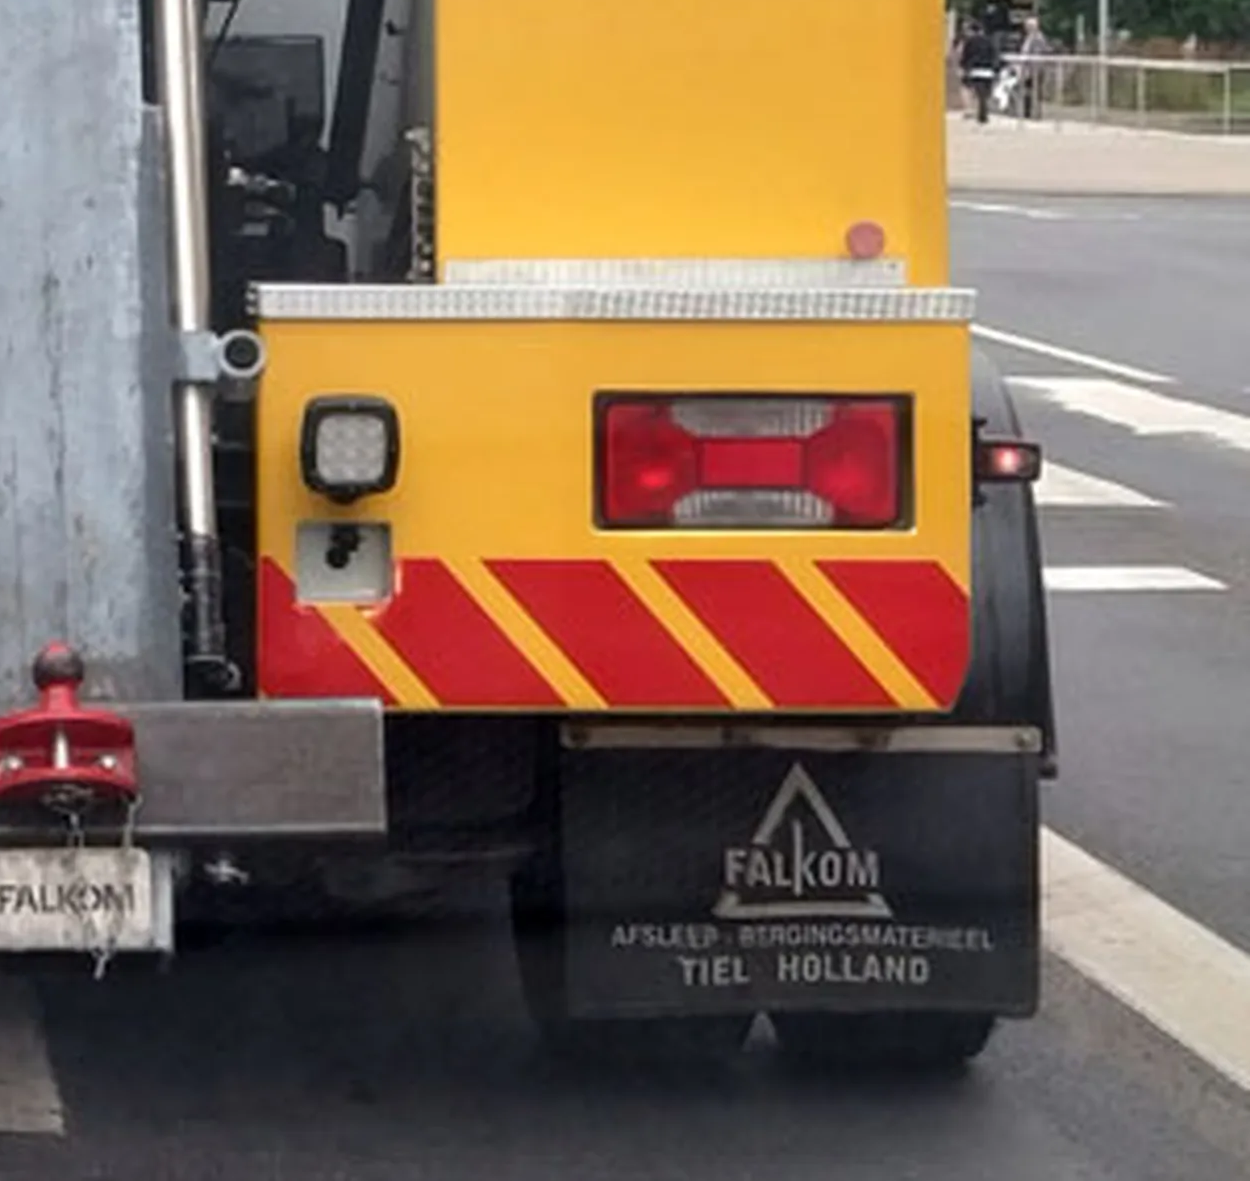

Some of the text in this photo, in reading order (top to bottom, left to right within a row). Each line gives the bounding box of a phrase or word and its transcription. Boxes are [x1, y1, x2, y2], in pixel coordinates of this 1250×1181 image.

[723, 819, 881, 897] FALKOM
[677, 953, 931, 986] TIEL HOLLAND
